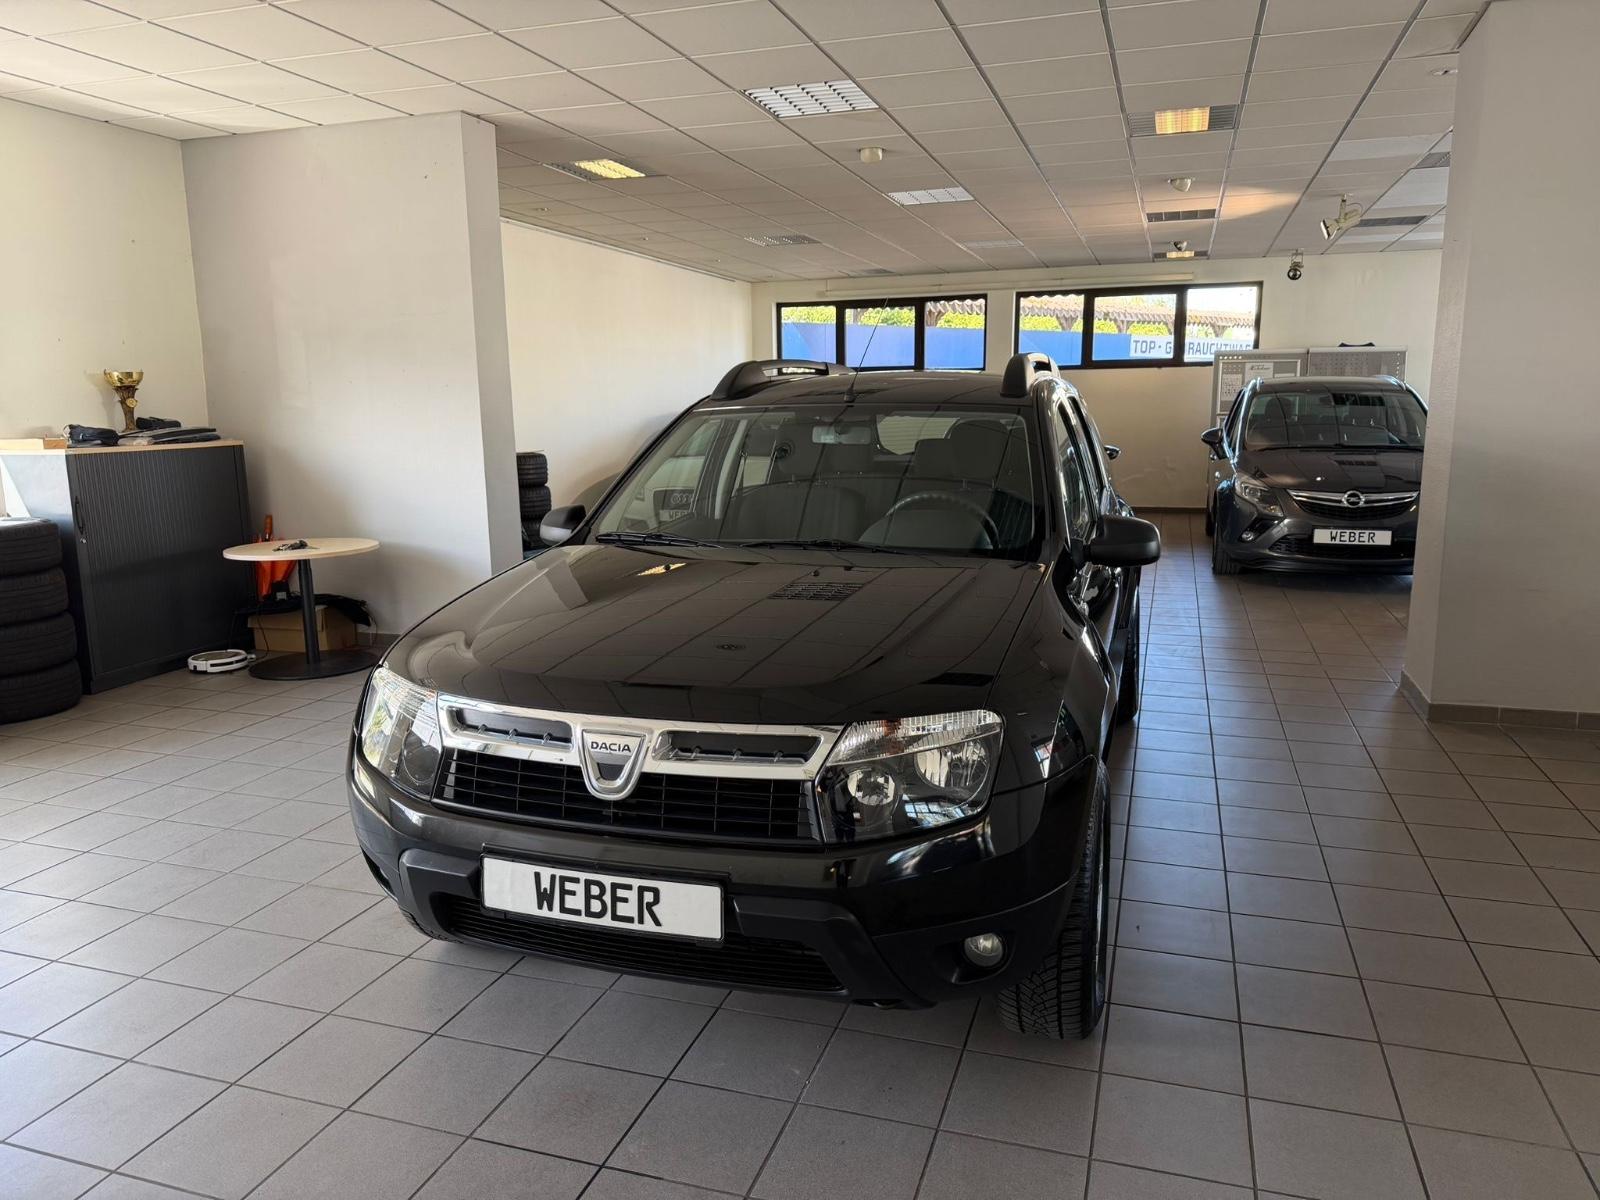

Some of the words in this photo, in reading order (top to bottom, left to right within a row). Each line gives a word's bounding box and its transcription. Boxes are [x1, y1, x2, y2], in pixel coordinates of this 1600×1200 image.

[1133, 340, 1156, 354] TOP
[1330, 531, 1376, 543] WEBER
[591, 741, 631, 753] DACIA
[534, 871, 662, 927] WEBER
